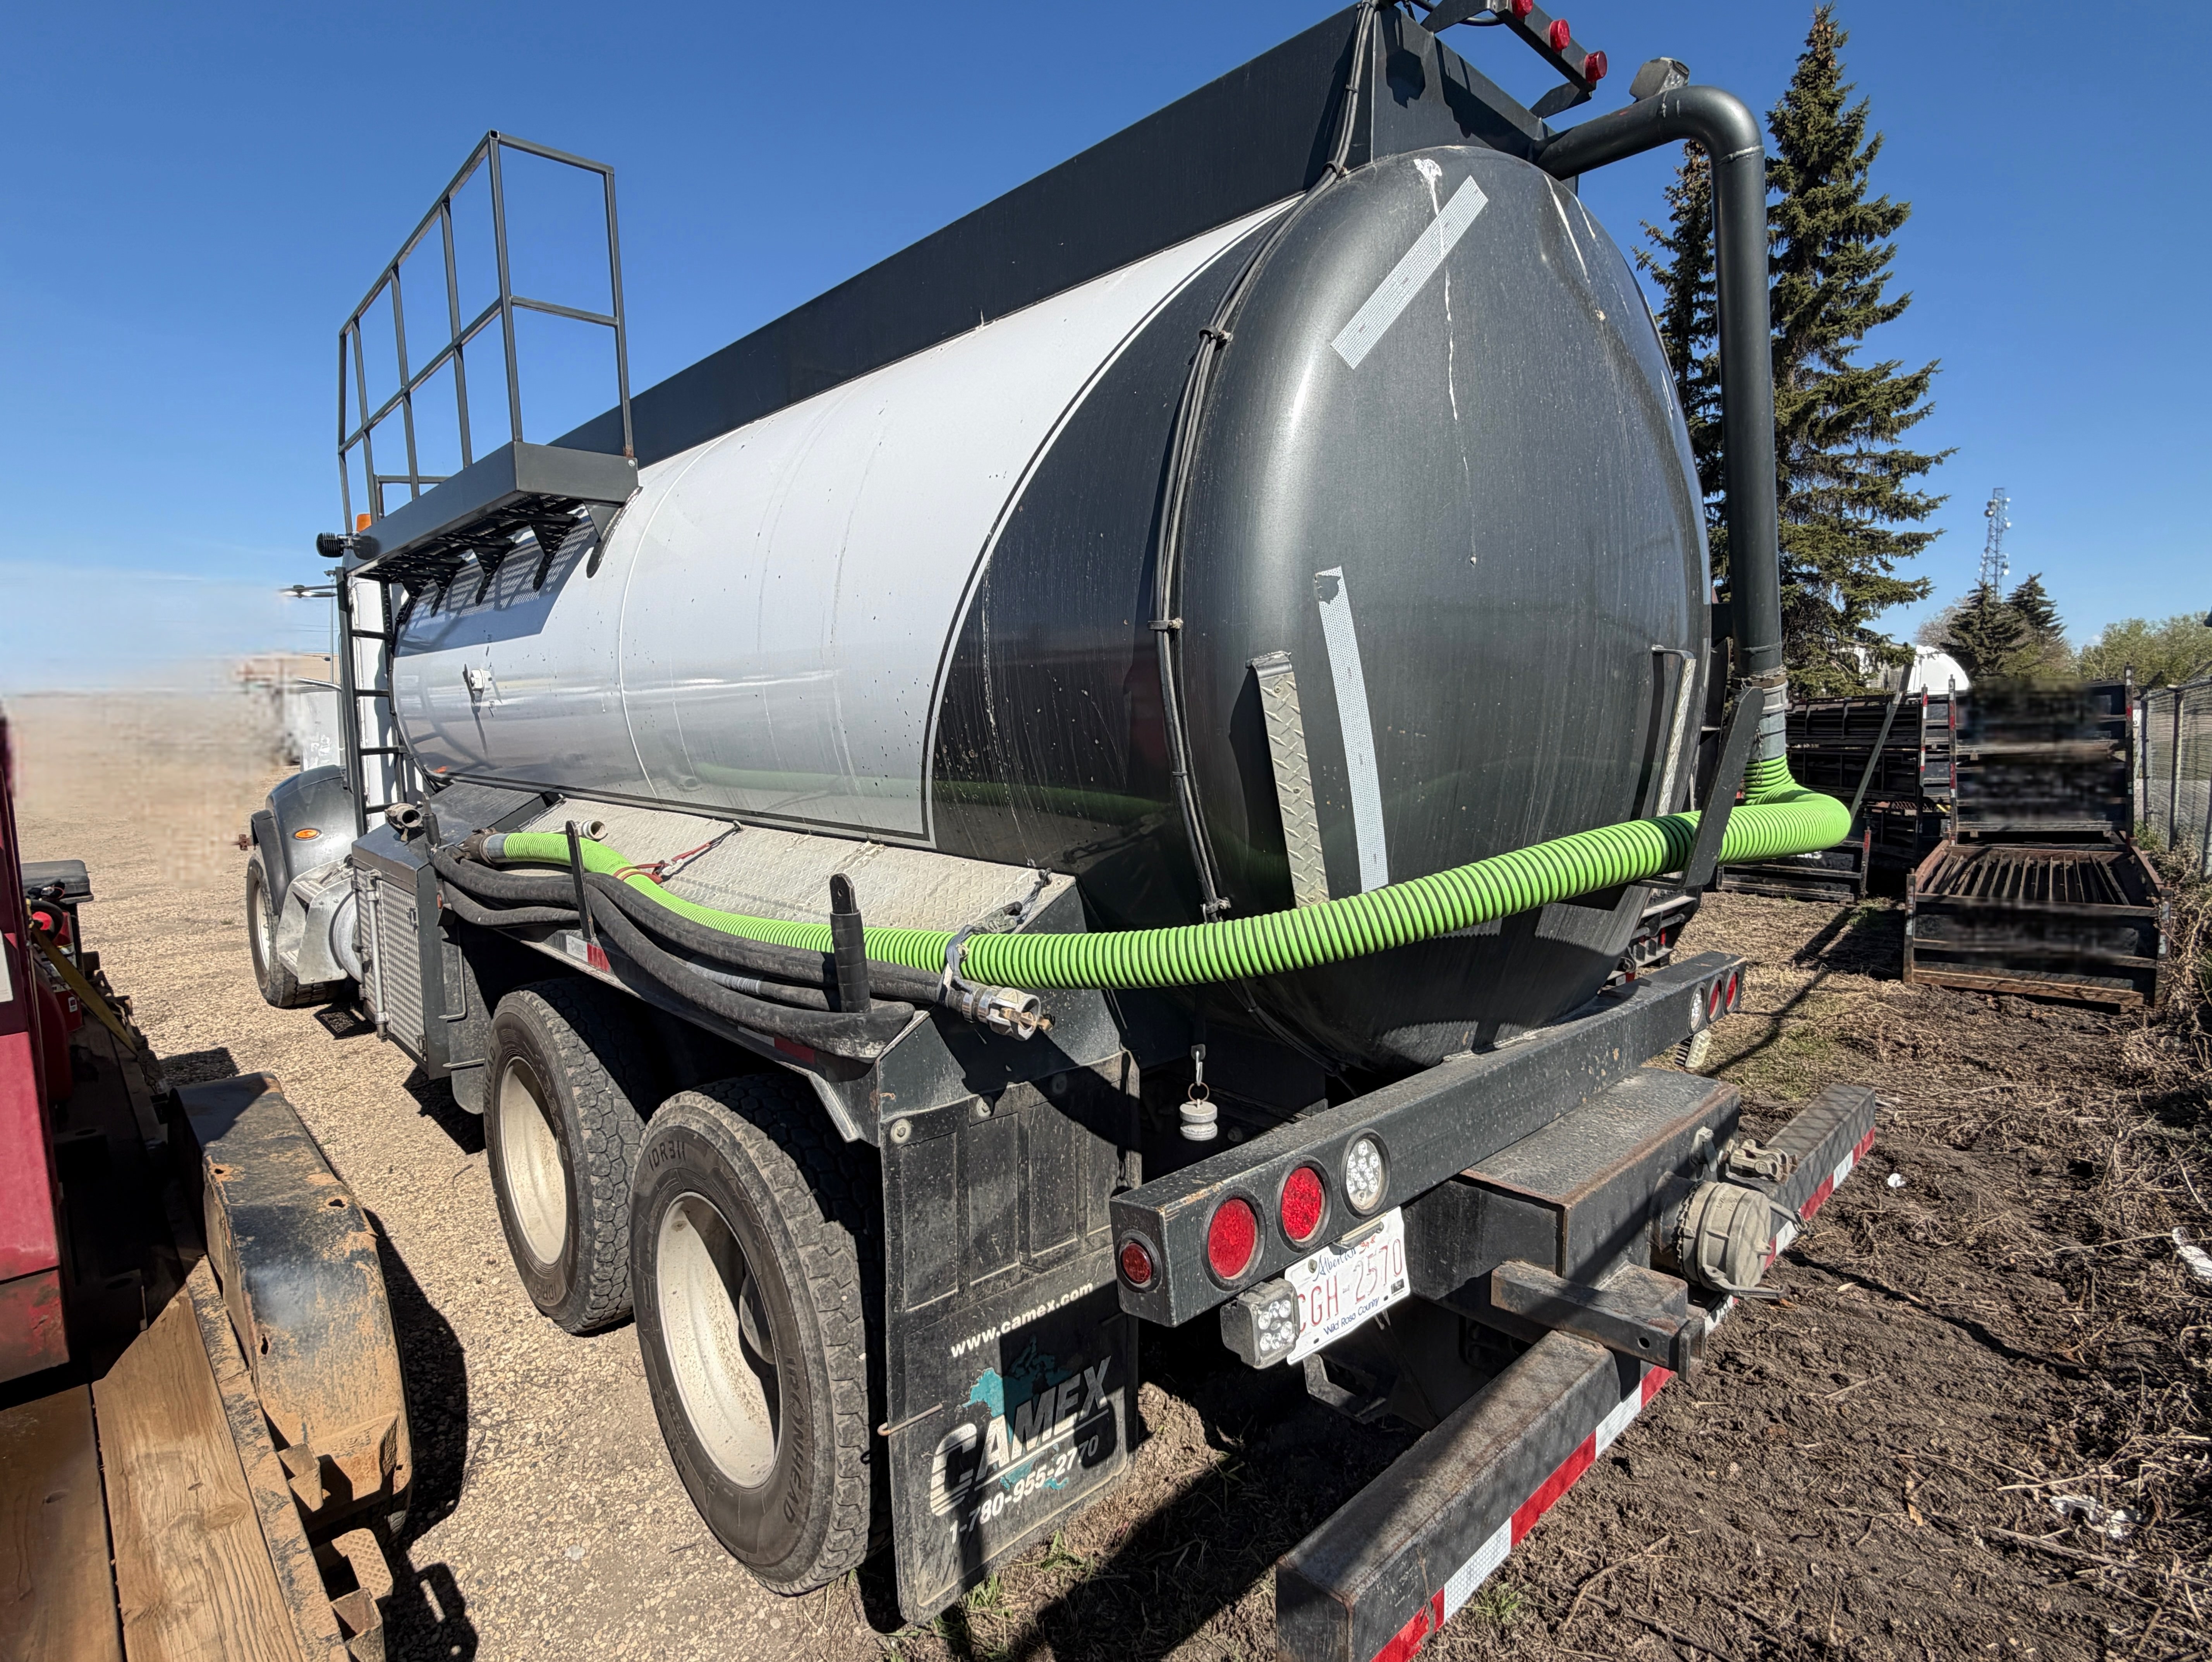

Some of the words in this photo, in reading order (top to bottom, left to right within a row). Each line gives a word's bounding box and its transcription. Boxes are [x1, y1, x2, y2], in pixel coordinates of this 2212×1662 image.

[951, 1283, 1094, 1357] www.camex.com
[930, 1355, 1111, 1516] CAMEX
[949, 1434, 1099, 1544] 1-780-955-2770
